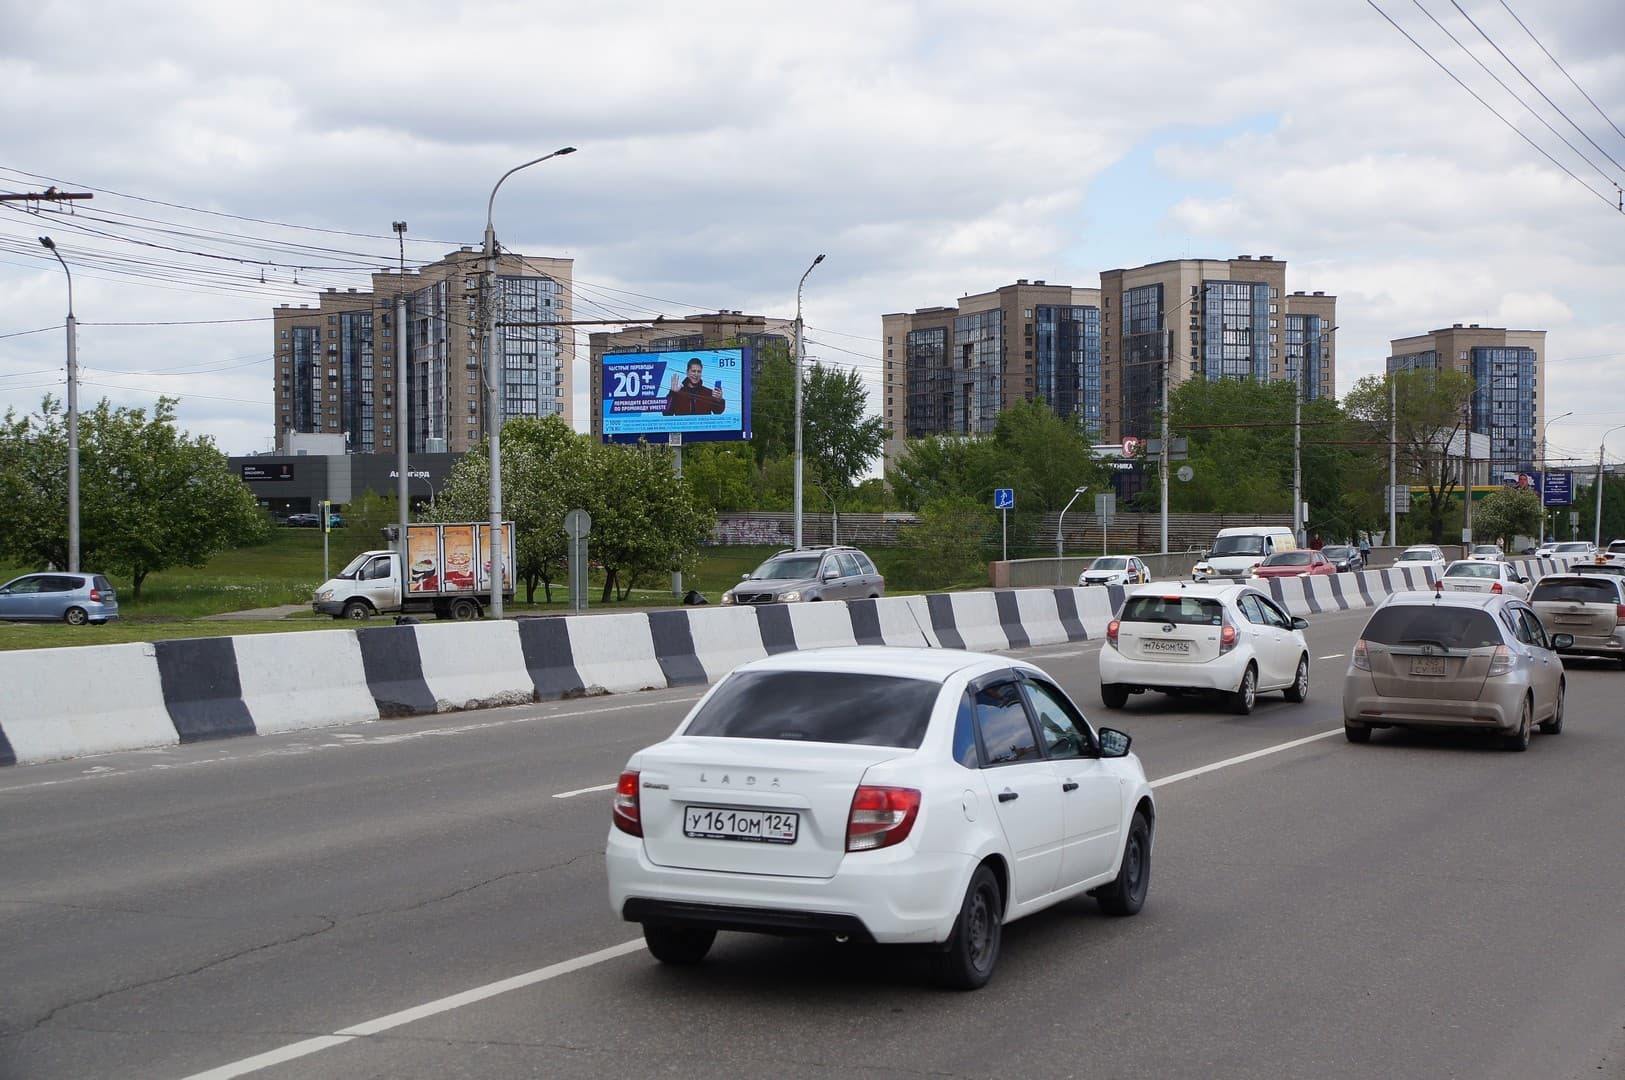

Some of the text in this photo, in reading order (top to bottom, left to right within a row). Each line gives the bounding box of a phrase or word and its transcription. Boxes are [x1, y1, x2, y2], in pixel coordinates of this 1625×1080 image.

[719, 358, 736, 367] ВТБ
[700, 773, 781, 787] LADA
[692, 811, 793, 834] У161ОМ 124
